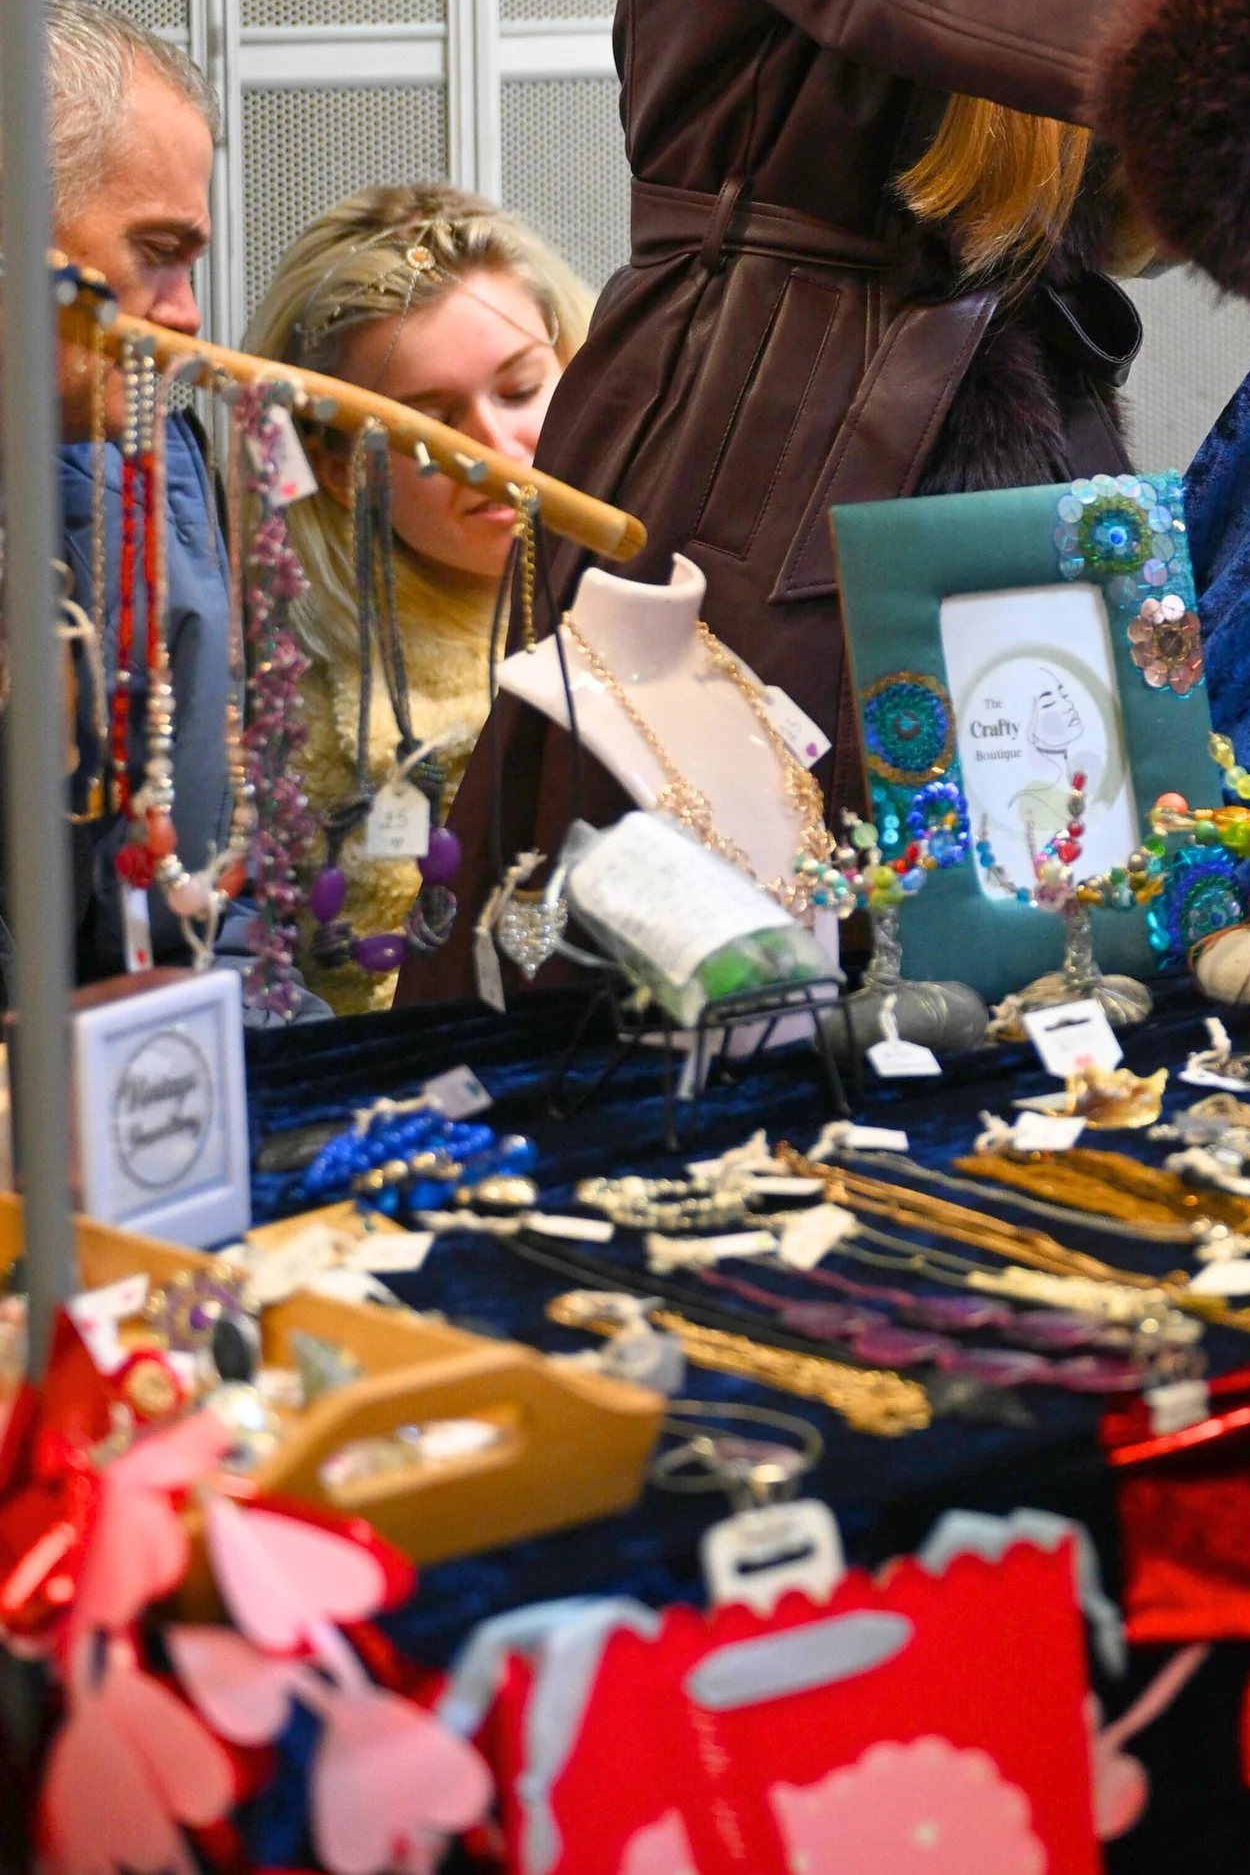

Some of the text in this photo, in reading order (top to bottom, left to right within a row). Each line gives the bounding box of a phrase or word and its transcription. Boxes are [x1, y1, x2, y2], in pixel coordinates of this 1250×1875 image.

[984, 698, 1004, 710] The
[970, 717, 1020, 741] Crafty
[976, 749, 1023, 762] Boutique
